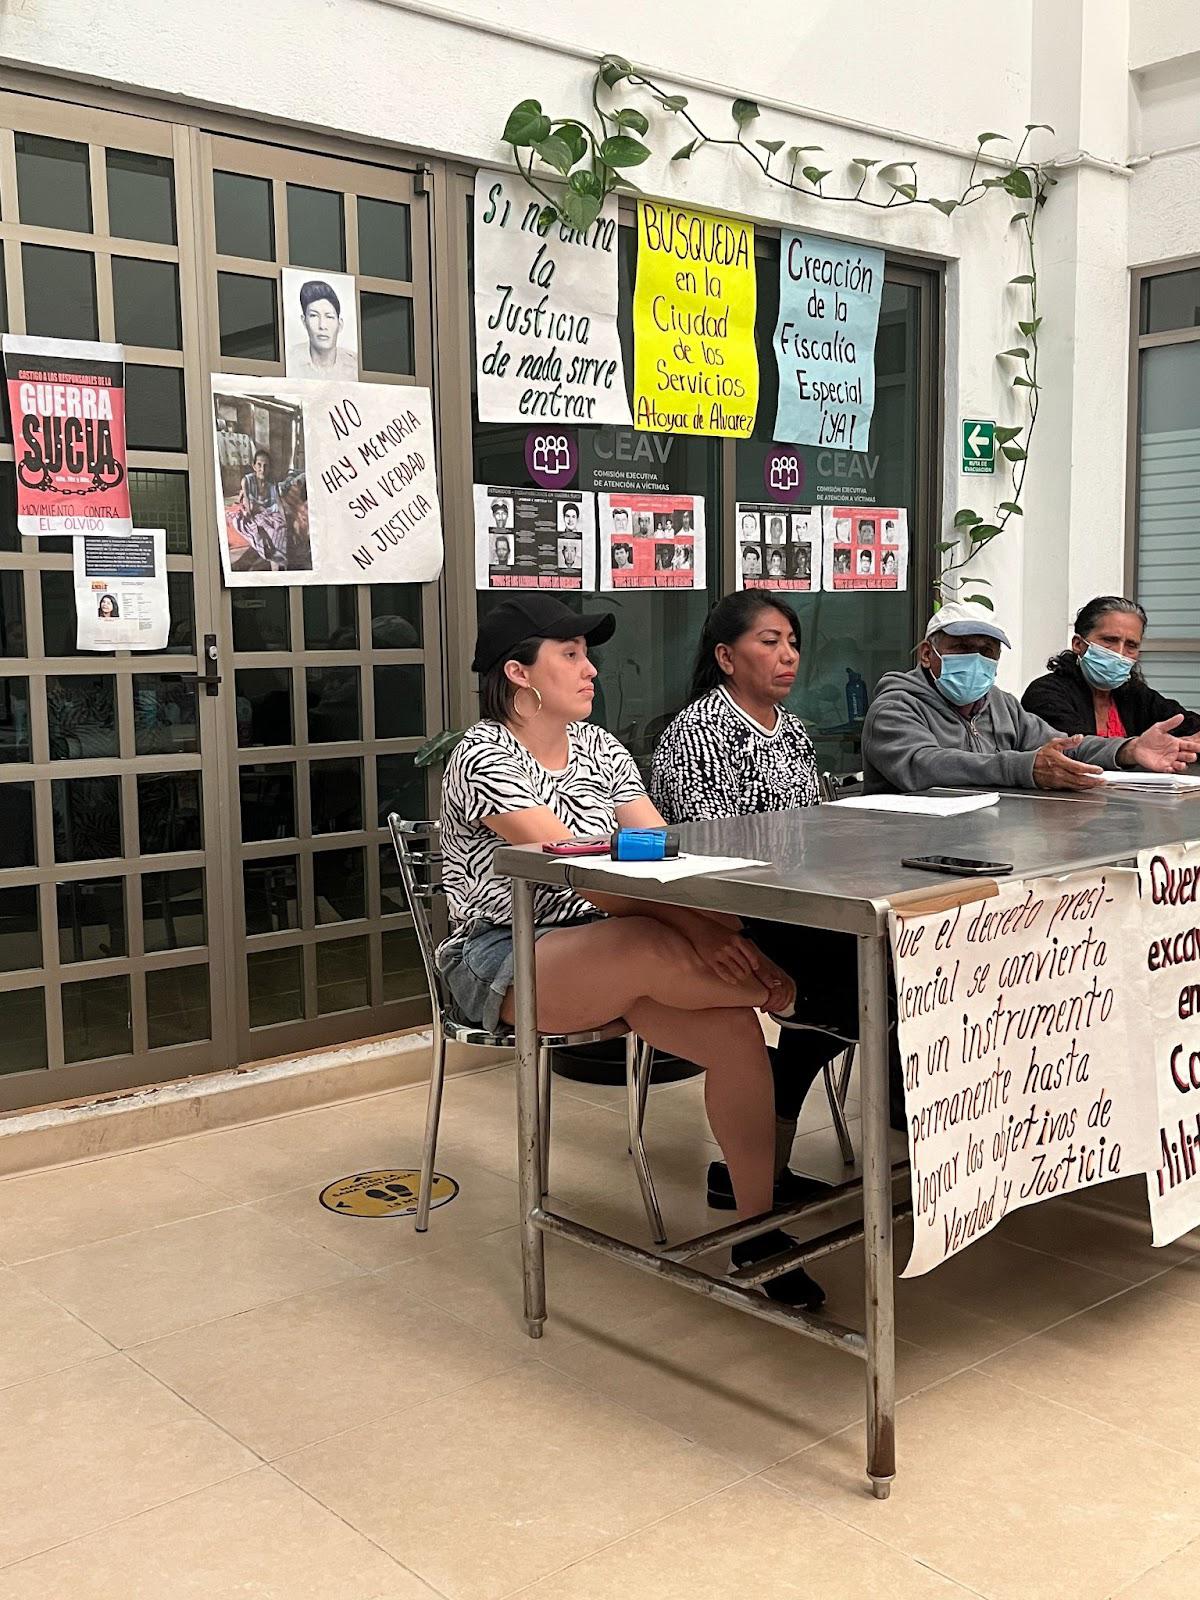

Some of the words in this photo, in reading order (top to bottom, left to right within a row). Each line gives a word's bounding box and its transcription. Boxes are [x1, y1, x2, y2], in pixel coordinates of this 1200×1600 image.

[483, 183, 511, 228] Si
[643, 203, 749, 269] BÚSQUEDA
[528, 243, 555, 289] la
[676, 271, 697, 294] en
[705, 266, 721, 299] la
[788, 237, 873, 294] Creación
[488, 285, 590, 344] Justicia
[652, 295, 729, 338] Ciudad
[807, 289, 825, 319] de
[834, 291, 847, 323] la
[673, 337, 692, 363] de
[701, 341, 724, 366] los
[781, 322, 857, 364] Fiscalía
[482, 340, 511, 378] de
[515, 346, 561, 382] nada
[566, 354, 617, 389] sirve
[657, 358, 745, 398] Servicios
[19, 383, 113, 420] GUERRA
[519, 383, 596, 419] entrar
[796, 370, 862, 411] Especial
[328, 399, 362, 440] NO
[637, 395, 688, 433] Atoyac
[693, 405, 704, 430] de
[709, 402, 754, 433] Alvarez
[818, 410, 857, 450] ¡YA!
[22, 414, 115, 474] SUCIA
[321, 455, 358, 494] HAY
[358, 410, 421, 467] MEMORIA
[594, 431, 674, 463] CEAV
[817, 451, 880, 479] CEAV
[348, 488, 379, 520] SIN
[377, 452, 426, 498] VERDAD
[593, 469, 625, 479] COMISIÓN
[626, 472, 658, 480] EJECUTIVA
[603, 480, 635, 489] ATENCIÓN
[642, 482, 669, 491] VÍCTIMAS
[22, 504, 75, 517] MOVIMIENTO
[83, 506, 120, 519] CONTRA
[39, 517, 56, 531] EL
[64, 517, 104, 531] OLVIDO
[352, 545, 375, 570] NI
[371, 494, 432, 552] JUSTICIA
[935, 902, 961, 951] el
[967, 889, 1044, 942] decreto
[1046, 877, 1114, 938] presi-
[967, 964, 990, 998] se
[999, 926, 1107, 988] convierta
[927, 1035, 949, 1076] un
[962, 975, 1114, 1064] instrumento
[912, 1057, 1012, 1170] permanente
[1022, 1039, 1089, 1094] hasta
[917, 1151, 959, 1227] lograr
[966, 1133, 984, 1177] los
[992, 1104, 1077, 1172] objetivos
[1088, 1088, 1112, 1128] de
[944, 1176, 998, 1257] Verdad
[1000, 1179, 1012, 1218] y
[1020, 1137, 1121, 1198] Justicia
